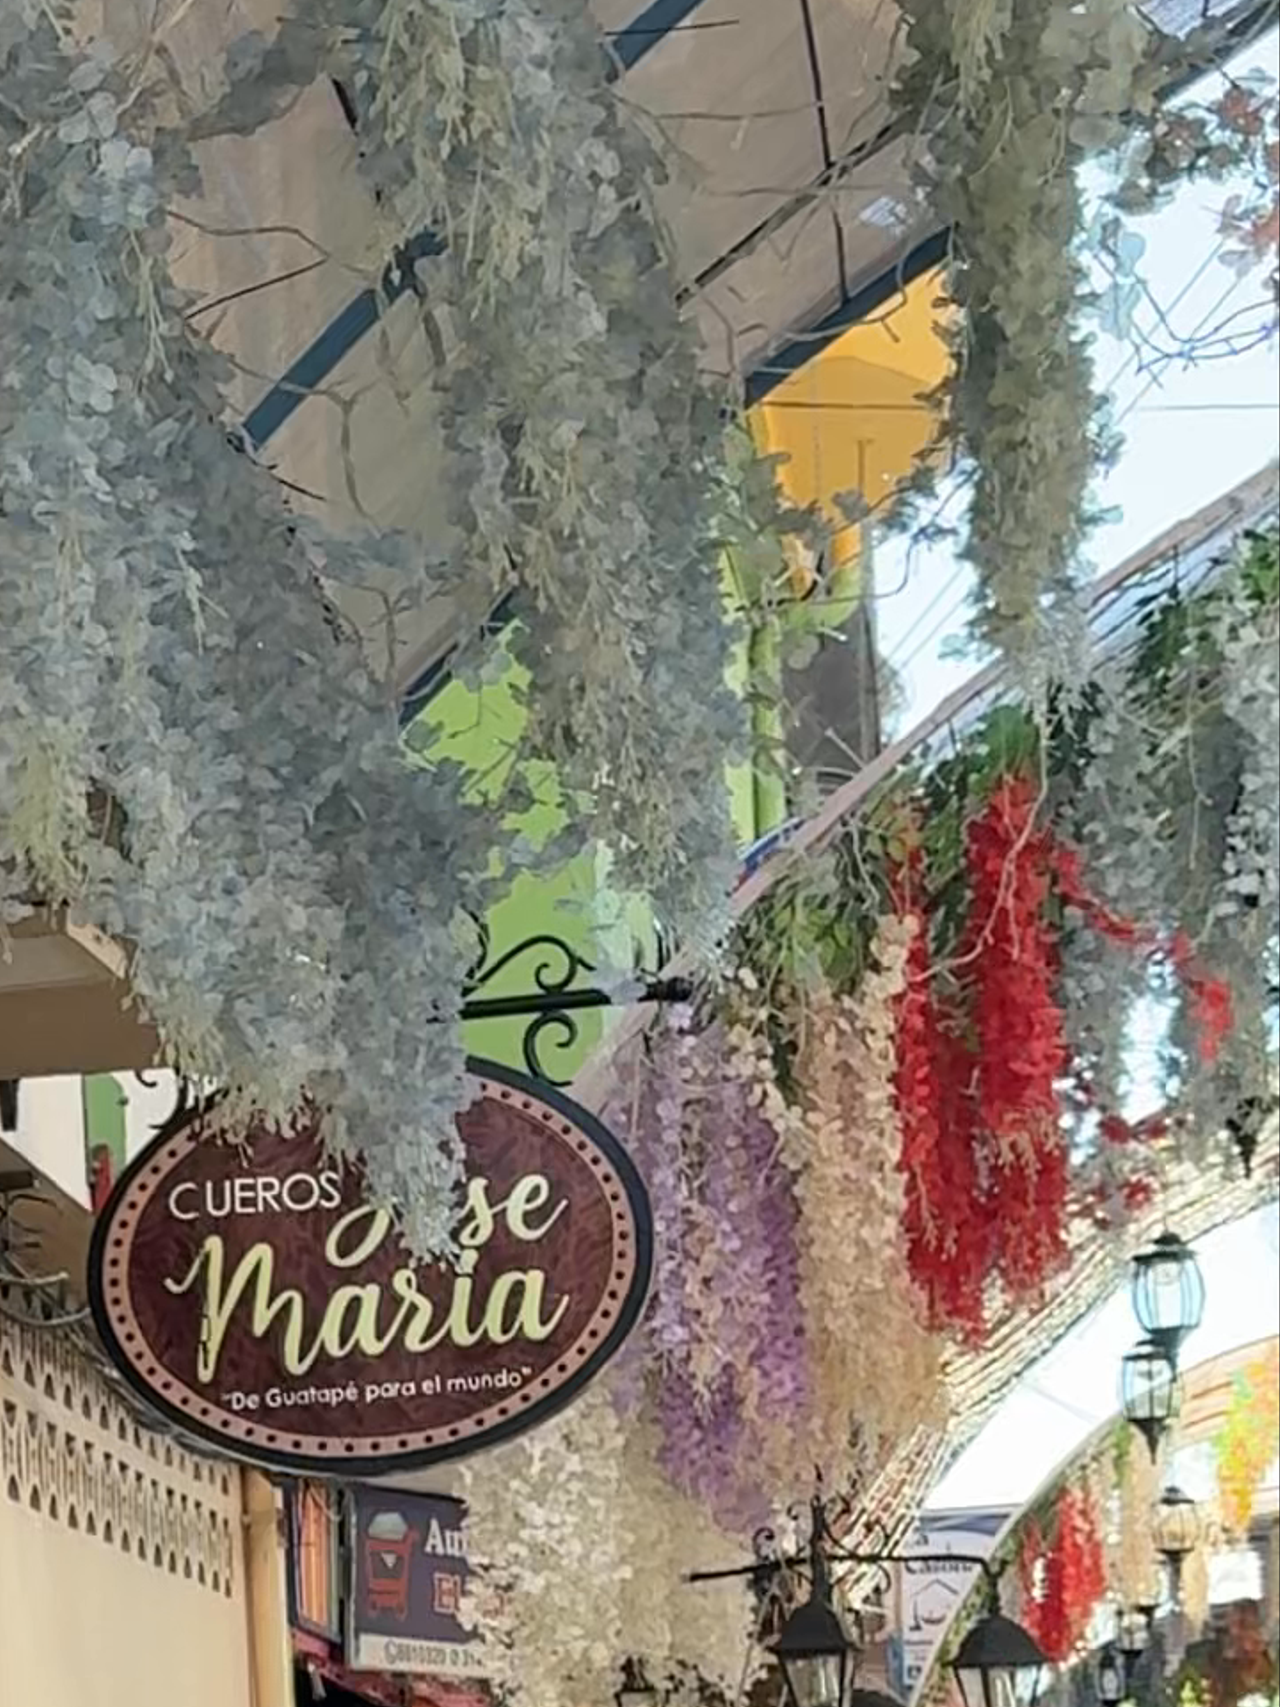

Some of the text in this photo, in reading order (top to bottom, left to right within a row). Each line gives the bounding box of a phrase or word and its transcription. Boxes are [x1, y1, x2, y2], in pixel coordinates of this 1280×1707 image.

[168, 1172, 341, 1221] CUEROS
[265, 1380, 359, 1410] Guatapé
[365, 1380, 416, 1403] para
[422, 1374, 441, 1395] el
